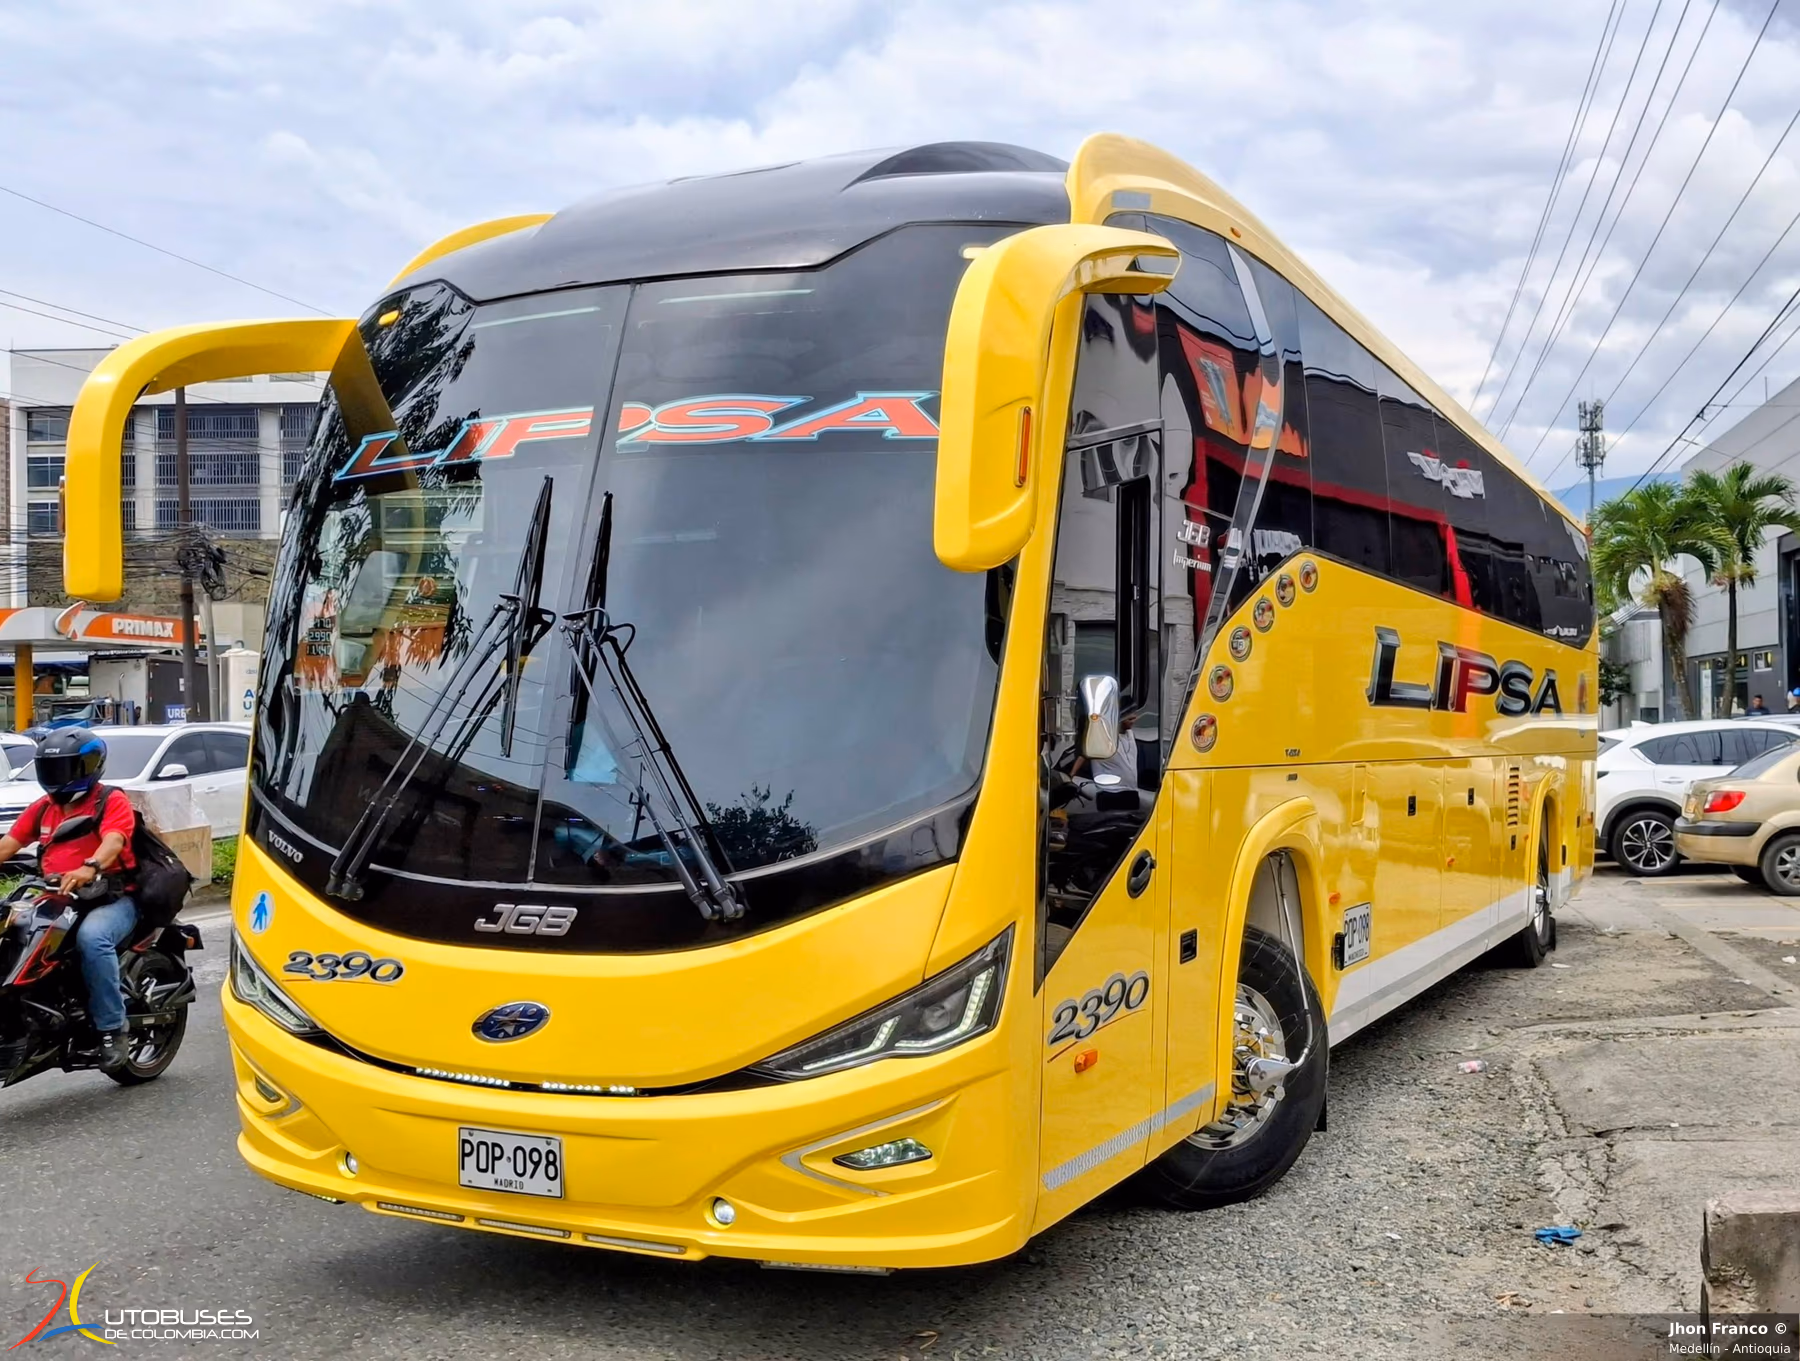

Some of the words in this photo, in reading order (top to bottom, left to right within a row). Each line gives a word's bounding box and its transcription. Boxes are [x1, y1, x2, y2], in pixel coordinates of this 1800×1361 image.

[334, 391, 942, 481] LIPSA
[1173, 548, 1212, 572] Imperium
[111, 617, 175, 638] PRIMAX
[1366, 625, 1563, 717] LIPSA
[268, 829, 304, 864] VOLVO
[474, 903, 578, 937] JGB
[283, 950, 404, 982] 2390
[1047, 970, 1150, 1046] 2390
[494, 1178, 524, 1190] MADRID
